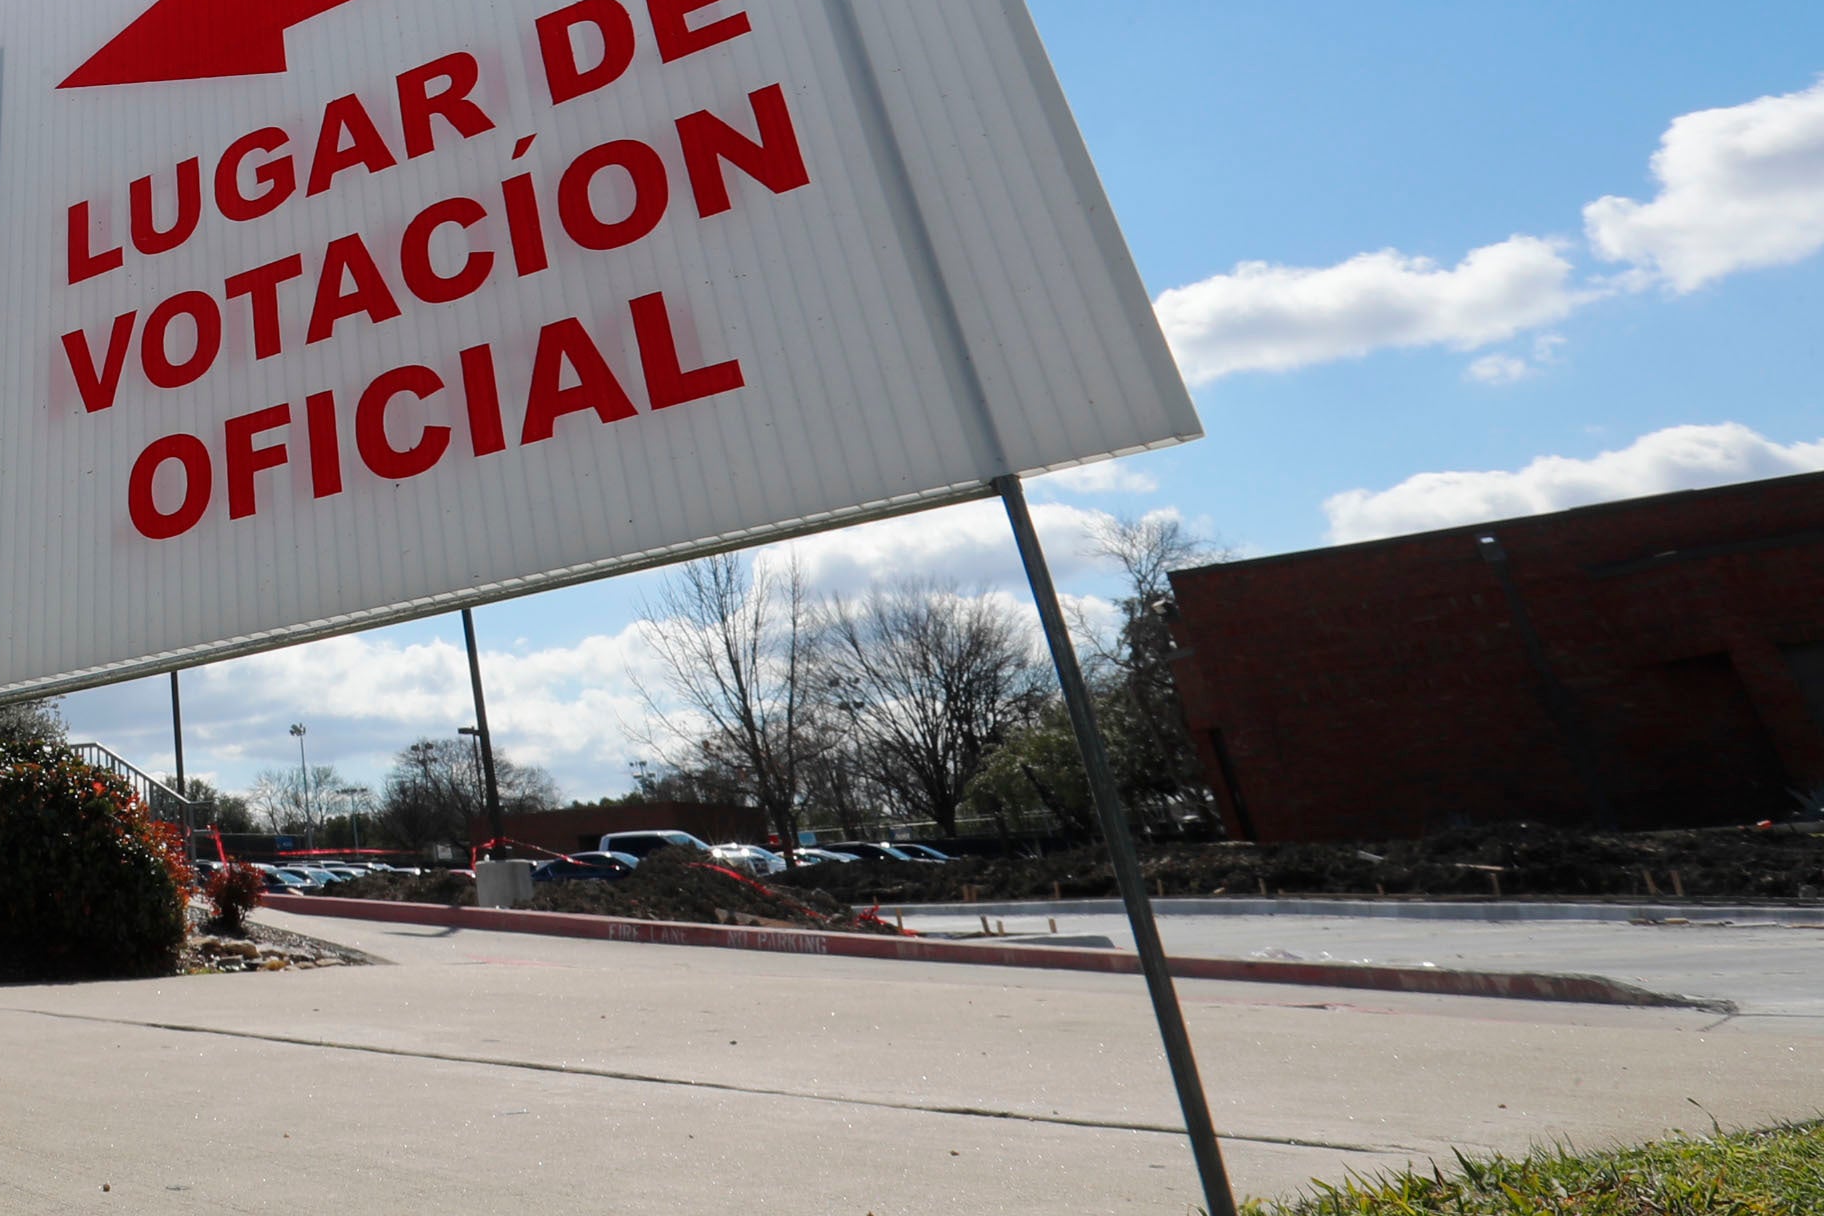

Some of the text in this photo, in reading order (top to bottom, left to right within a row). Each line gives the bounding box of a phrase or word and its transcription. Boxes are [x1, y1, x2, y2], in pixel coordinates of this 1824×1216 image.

[63, 85, 810, 412] VOTACÍON
[69, 53, 494, 284] LUGAR
[130, 293, 744, 539] OFICIAL
[608, 923, 640, 941] FIRE
[757, 933, 827, 954] PARKING
